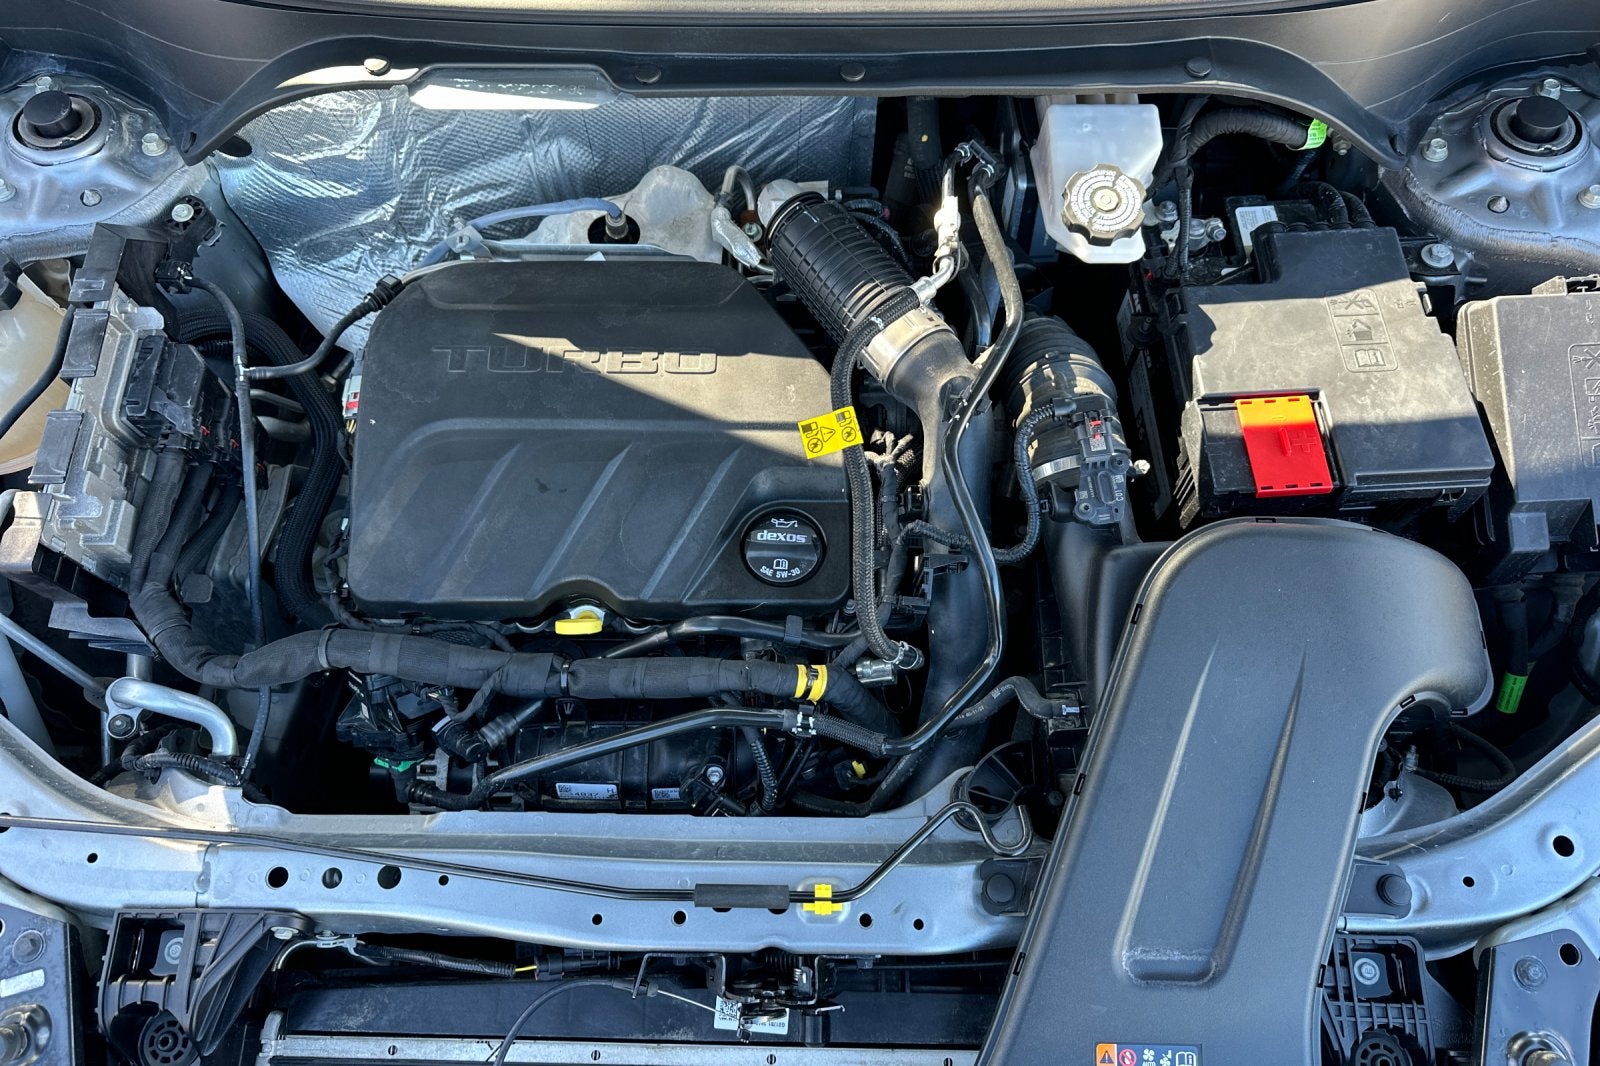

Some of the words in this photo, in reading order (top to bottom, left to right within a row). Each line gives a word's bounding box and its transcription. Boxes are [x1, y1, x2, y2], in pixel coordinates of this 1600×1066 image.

[431, 346, 717, 374] TURBO
[757, 530, 808, 543] dexos
[760, 565, 774, 577] SAE
[776, 567, 801, 579] 5W-30
